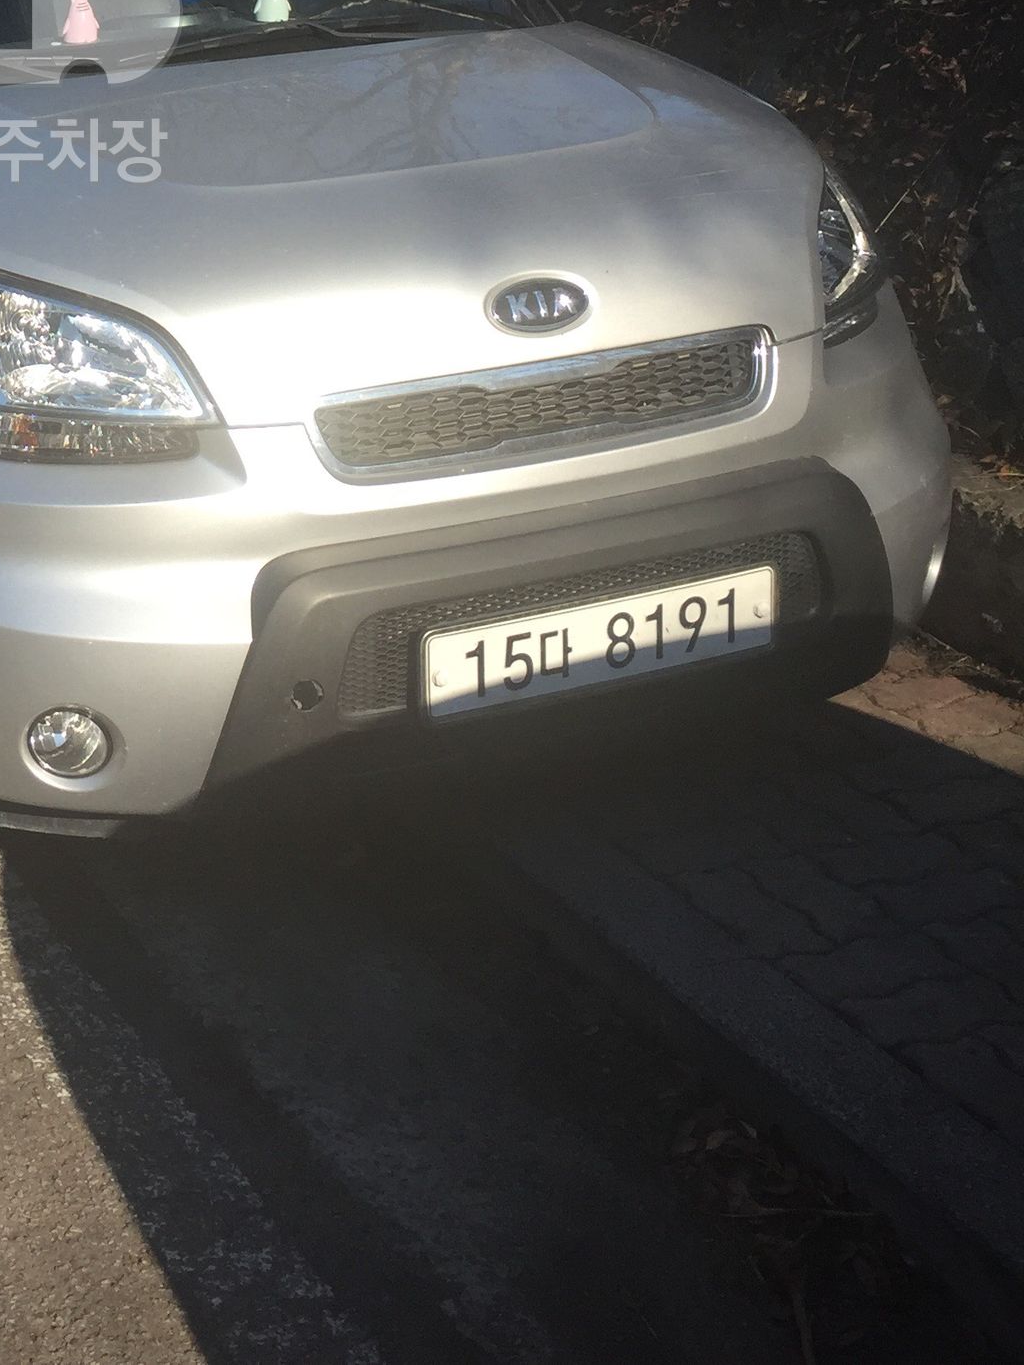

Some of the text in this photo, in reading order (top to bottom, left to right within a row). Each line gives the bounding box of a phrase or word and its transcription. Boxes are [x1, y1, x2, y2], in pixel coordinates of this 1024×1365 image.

[505, 287, 573, 322] KIA
[465, 588, 736, 698] 15다 8191
